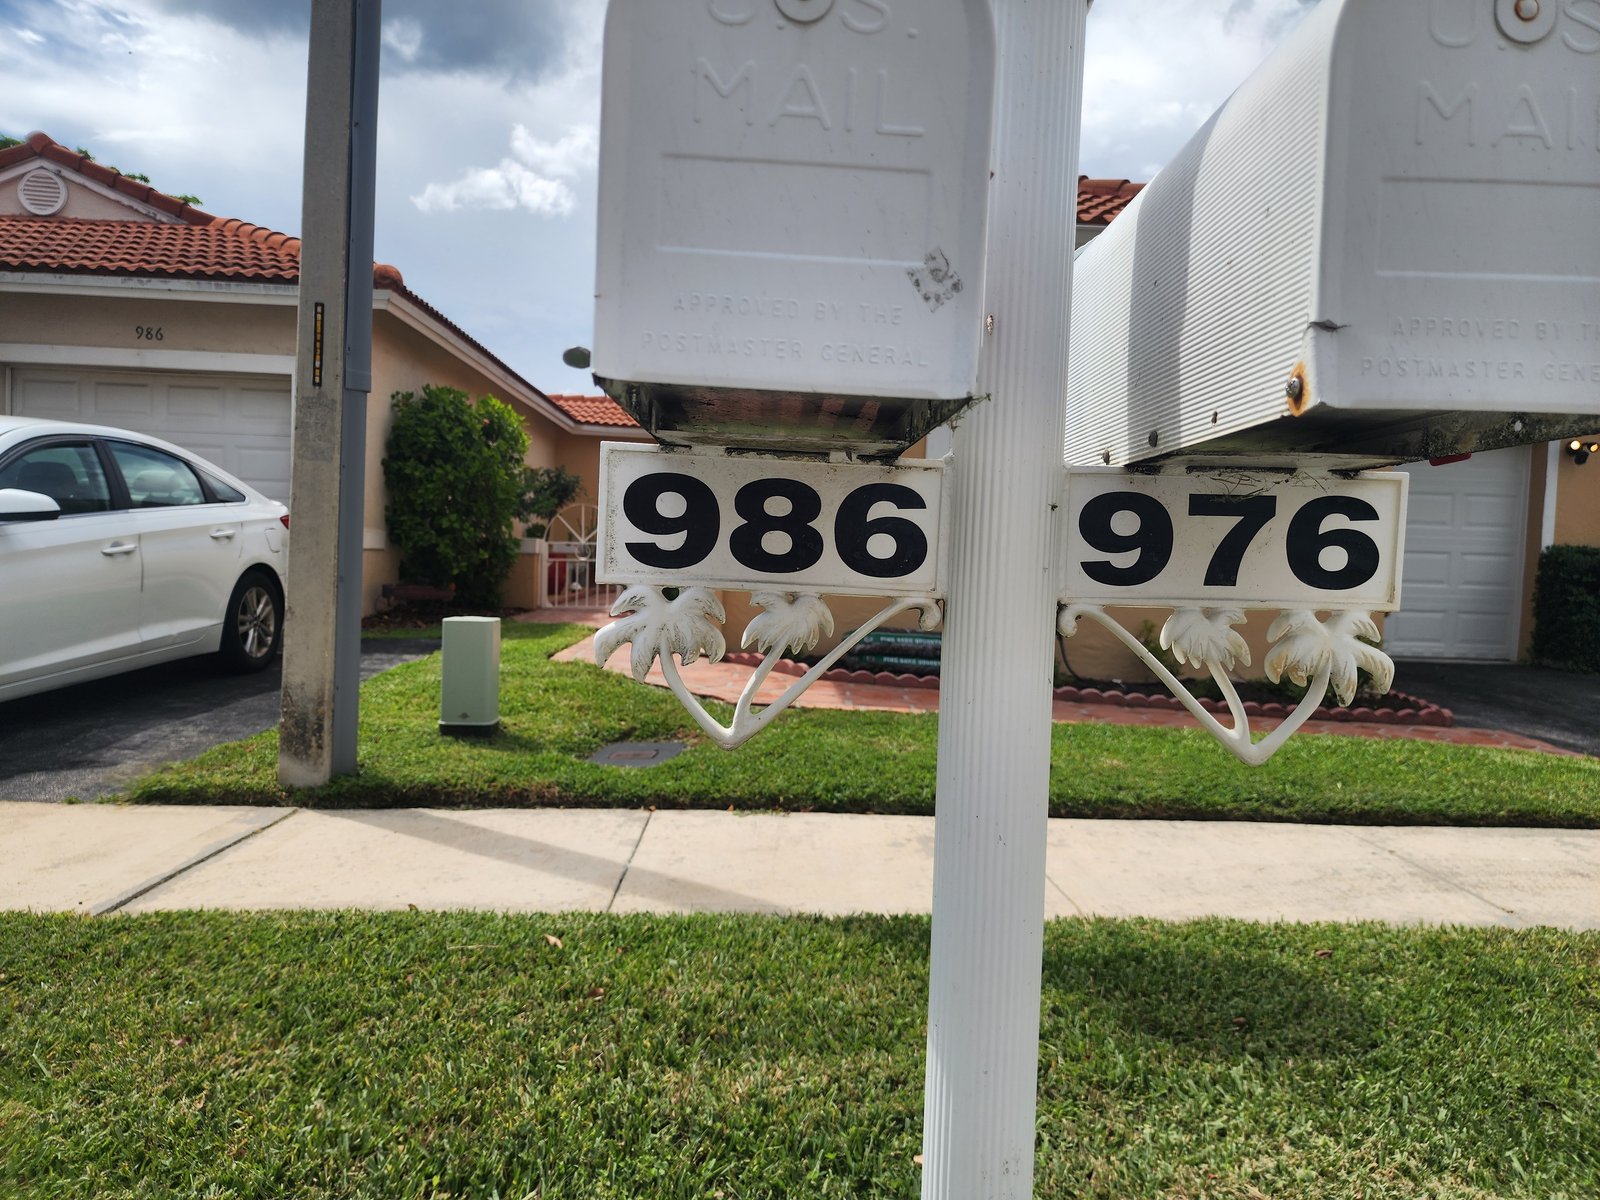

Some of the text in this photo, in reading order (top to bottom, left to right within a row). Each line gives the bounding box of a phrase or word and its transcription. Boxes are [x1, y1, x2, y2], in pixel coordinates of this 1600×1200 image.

[690, 56, 926, 138] MAIL
[1413, 79, 1600, 153] MAI
[673, 292, 903, 326] APPROVED BY THE
[135, 326, 164, 341] 986
[1392, 316, 1520, 340] APPROVED
[1534, 319, 1563, 341] BY
[640, 330, 930, 368] POSTMASTER GENERAL
[1360, 356, 1526, 380] POSTMASTER
[623, 472, 928, 578] 986
[1078, 491, 1380, 590] 976
